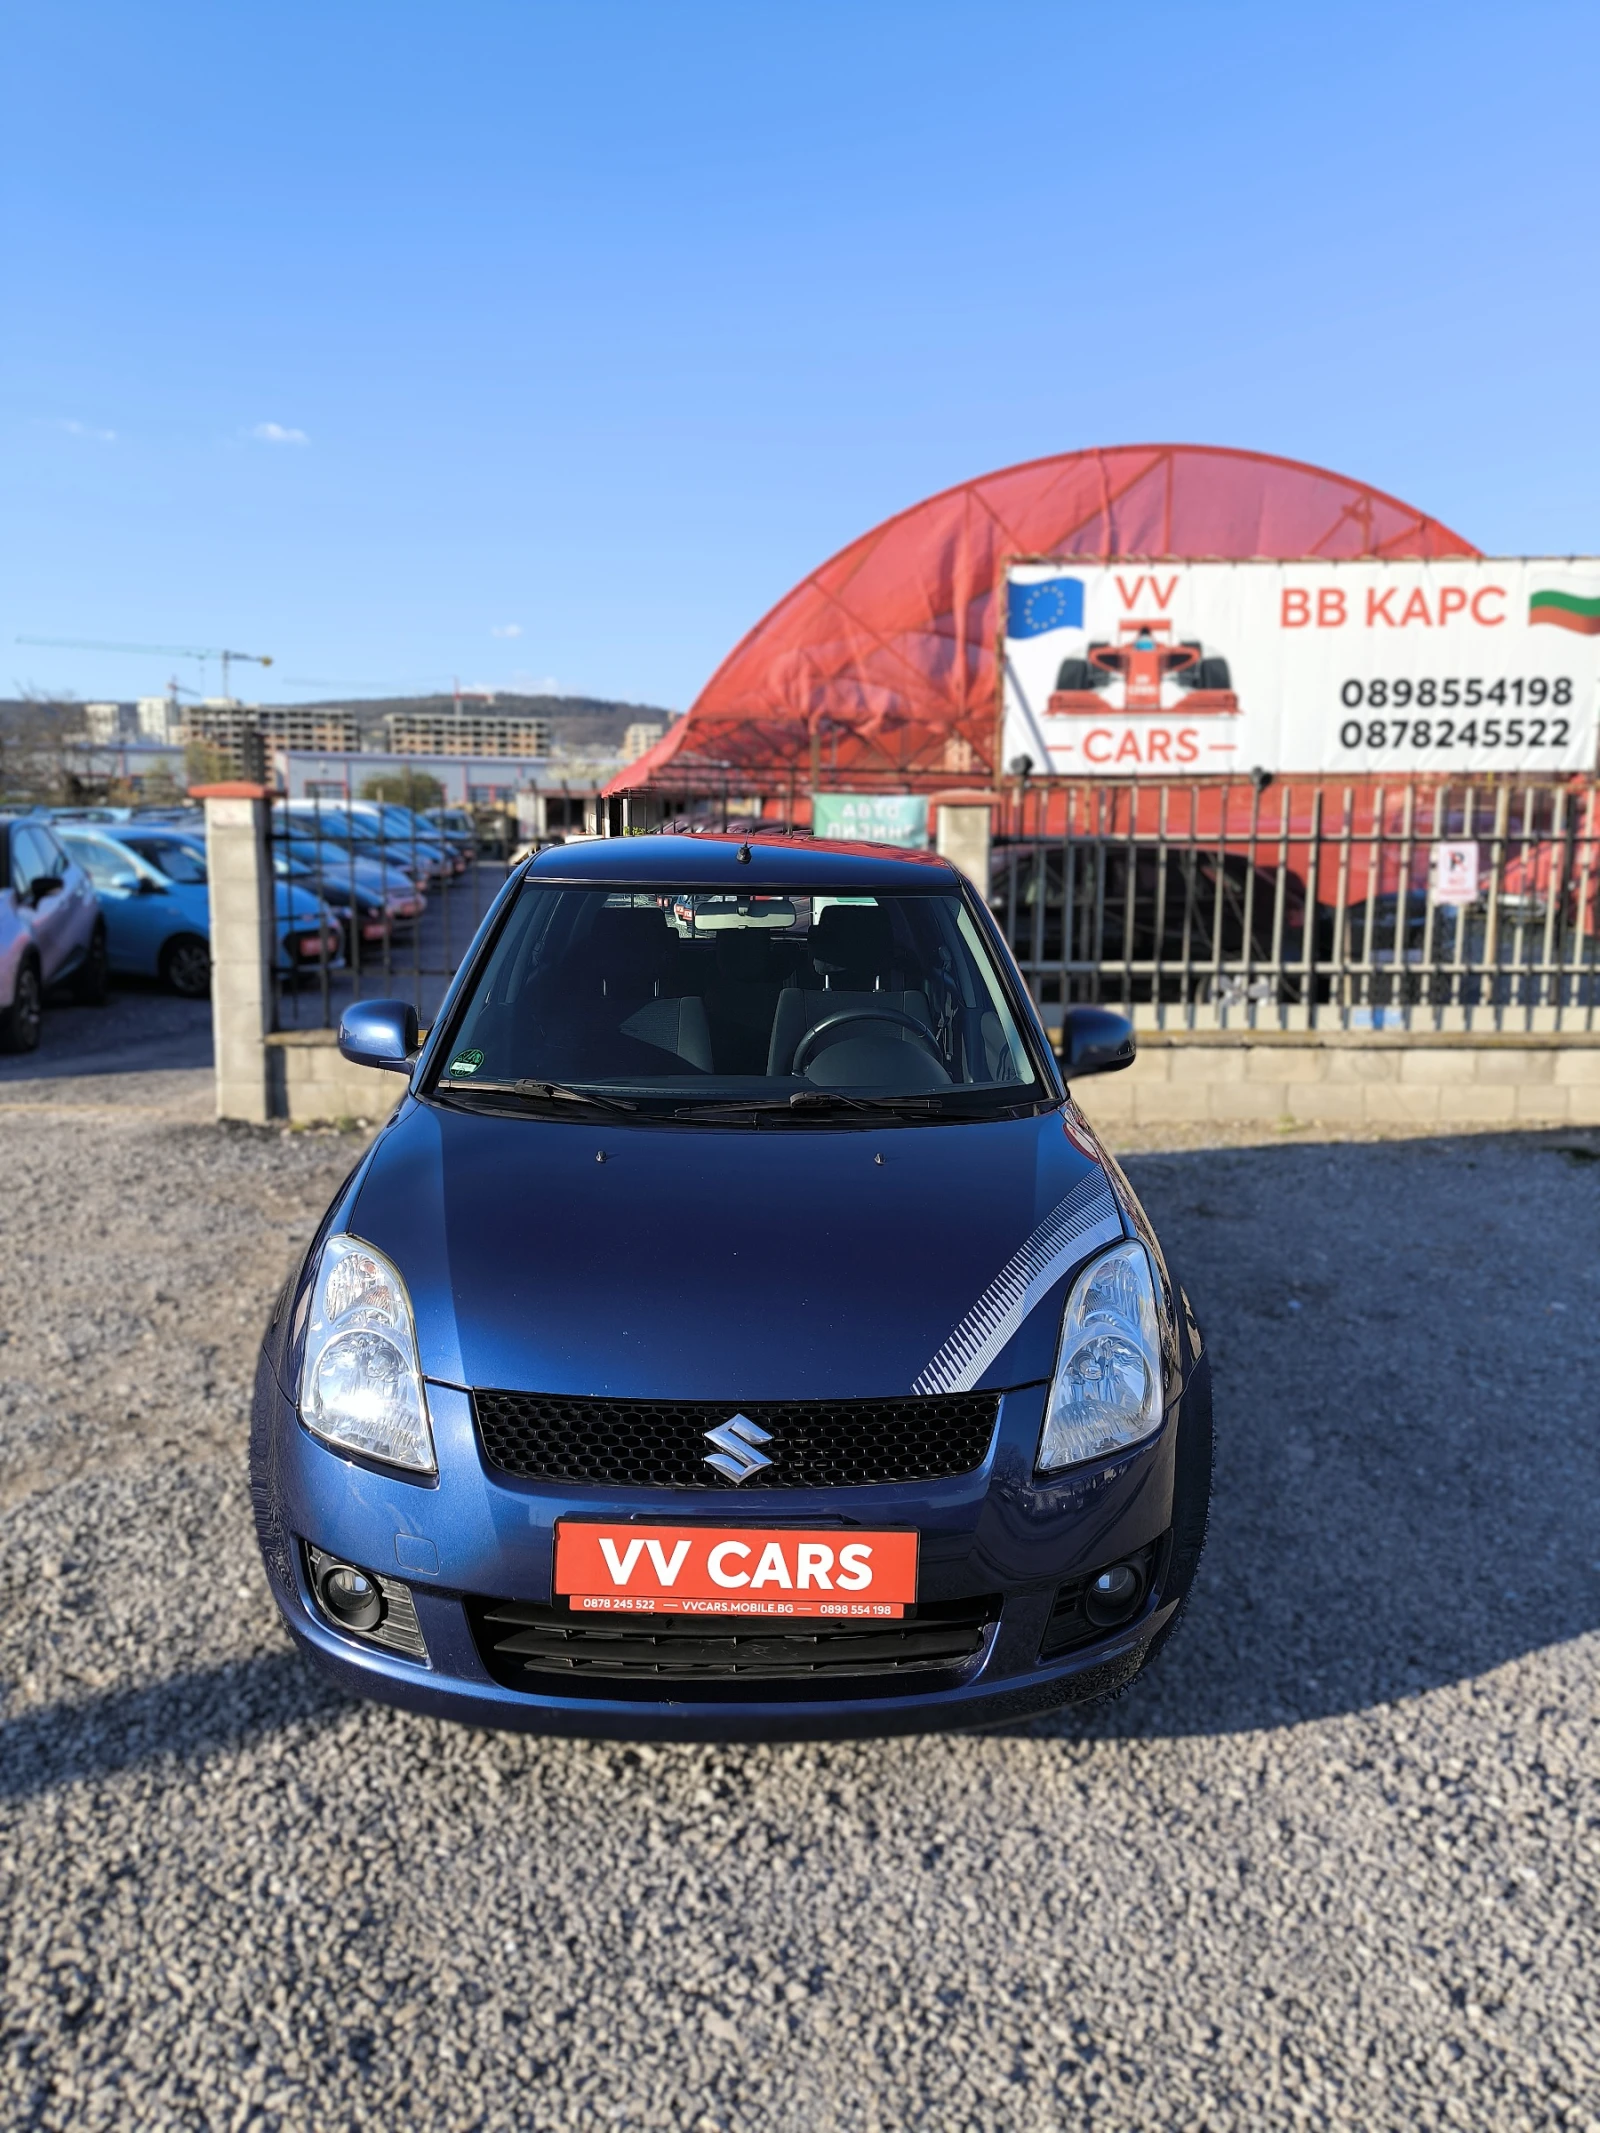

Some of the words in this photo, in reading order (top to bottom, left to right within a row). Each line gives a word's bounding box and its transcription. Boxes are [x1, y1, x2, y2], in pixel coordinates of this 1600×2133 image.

[1116, 576, 1178, 609] VV
[1281, 588, 1347, 628] ВВ
[1366, 586, 1506, 627] КАРС
[1341, 679, 1572, 707] 0898554198
[1083, 729, 1199, 763] CARS
[1340, 719, 1569, 748] 0878245522
[842, 802, 899, 820] АВТО
[599, 1538, 692, 1587] VV
[707, 1541, 873, 1591] CARS
[583, 1599, 610, 1609] 0878
[613, 1599, 633, 1609] 245
[635, 1600, 655, 1610] 522
[682, 1601, 794, 1614] VVCARS.MOBILE.BG
[820, 1604, 848, 1615] 0898
[850, 1605, 870, 1615] 554
[873, 1605, 892, 1615] 198
